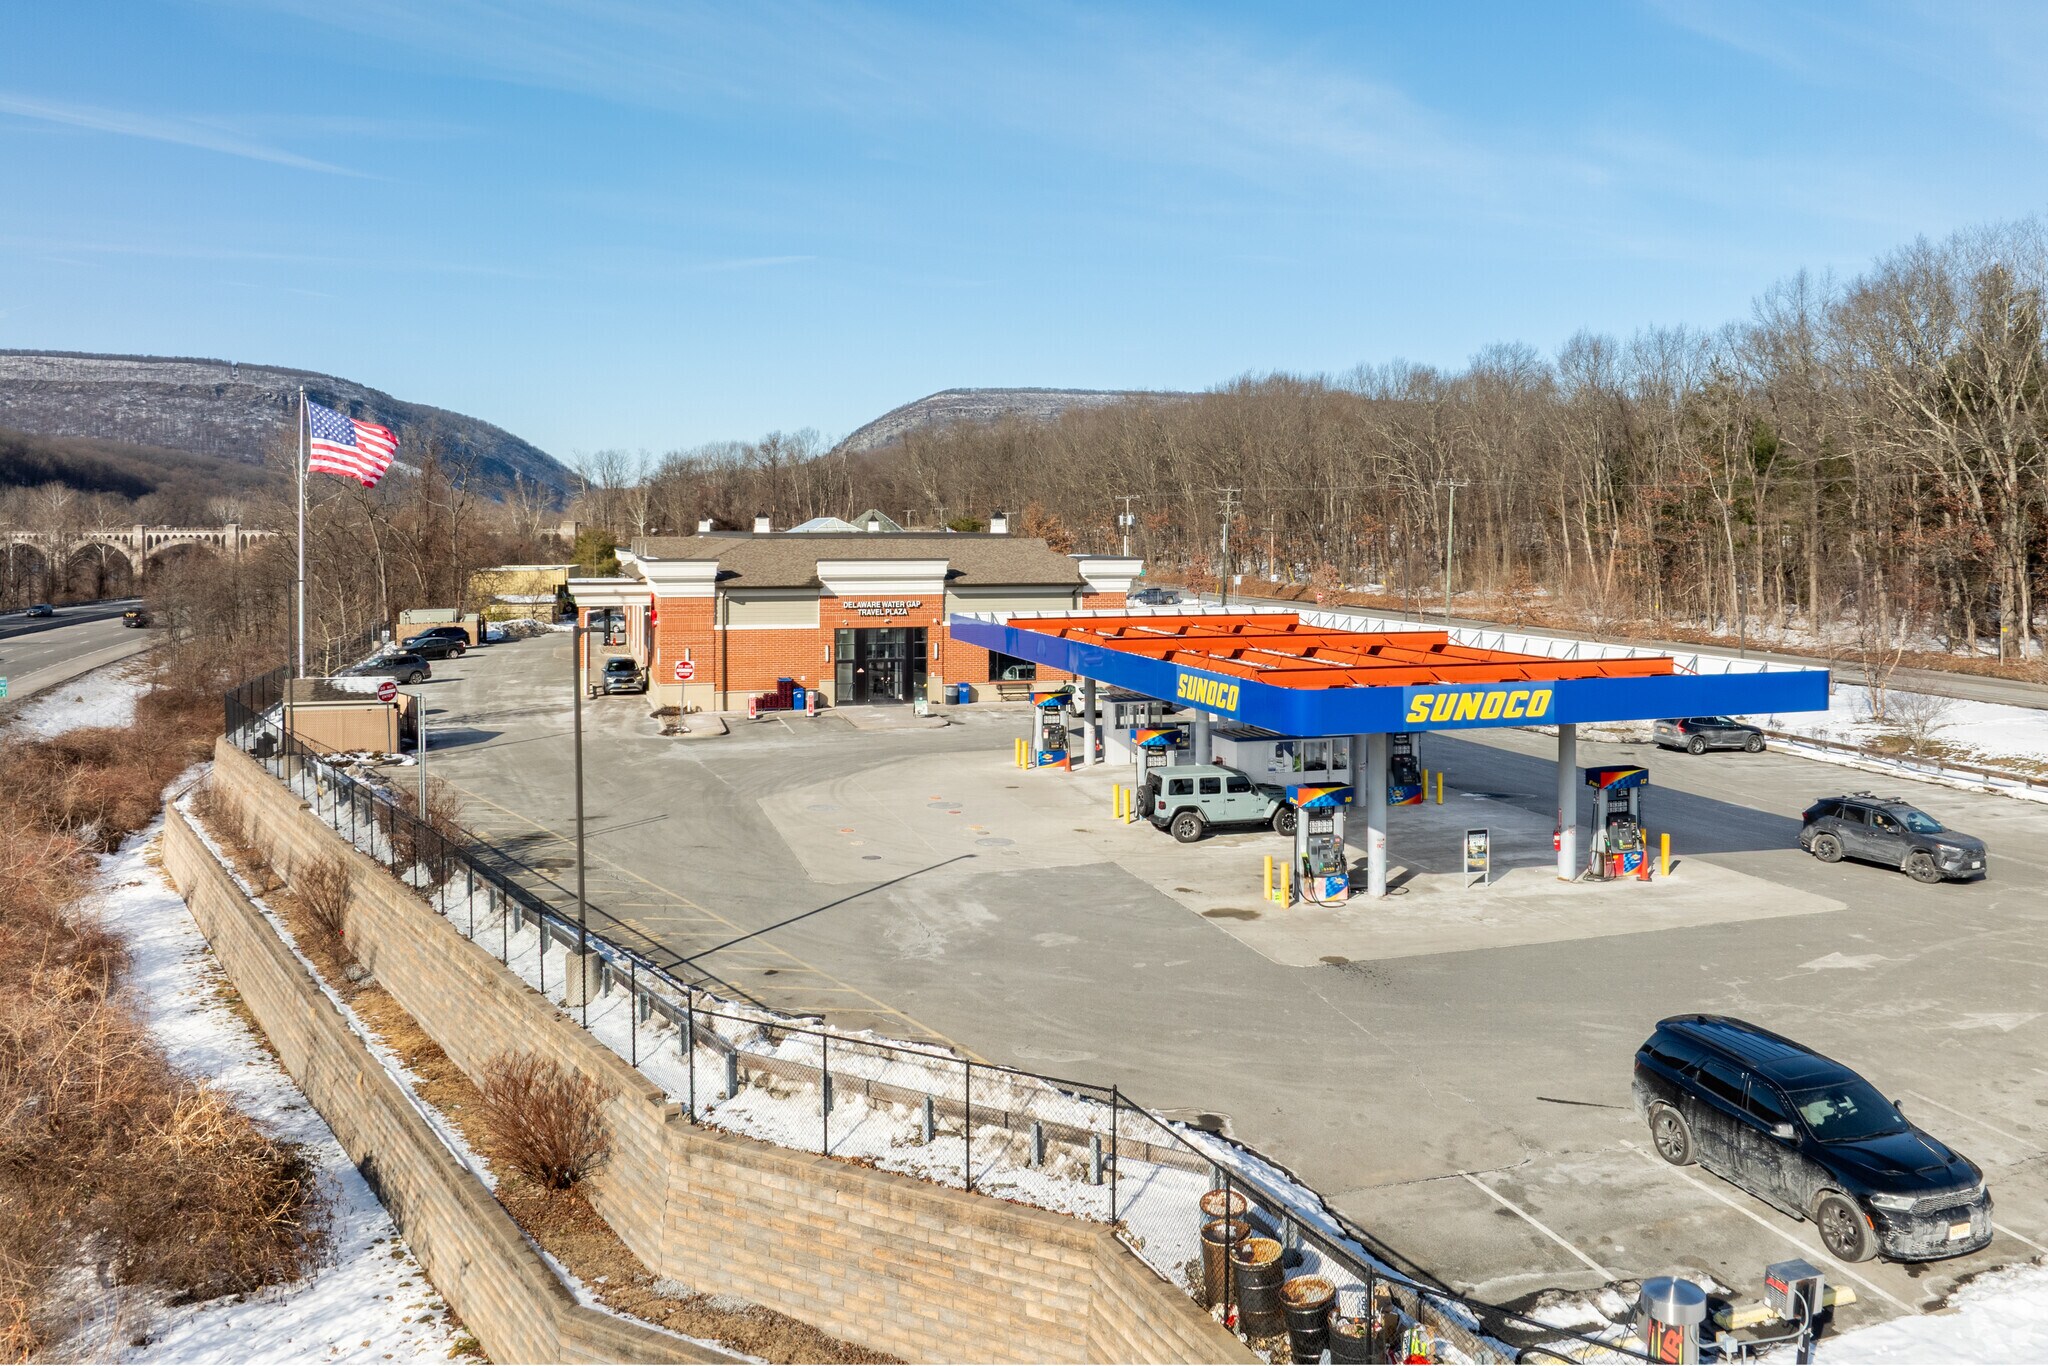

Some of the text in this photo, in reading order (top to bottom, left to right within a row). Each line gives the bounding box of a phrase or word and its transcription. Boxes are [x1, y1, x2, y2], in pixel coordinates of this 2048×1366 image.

[843, 601, 881, 609] DELAWARE
[906, 600, 921, 608] GAP
[858, 608, 908, 616] TRAVEL PLAZA
[1177, 673, 1240, 712] SUNOCO
[1405, 689, 1552, 723] SUNOCO
[1660, 1328, 1683, 1364] IR
